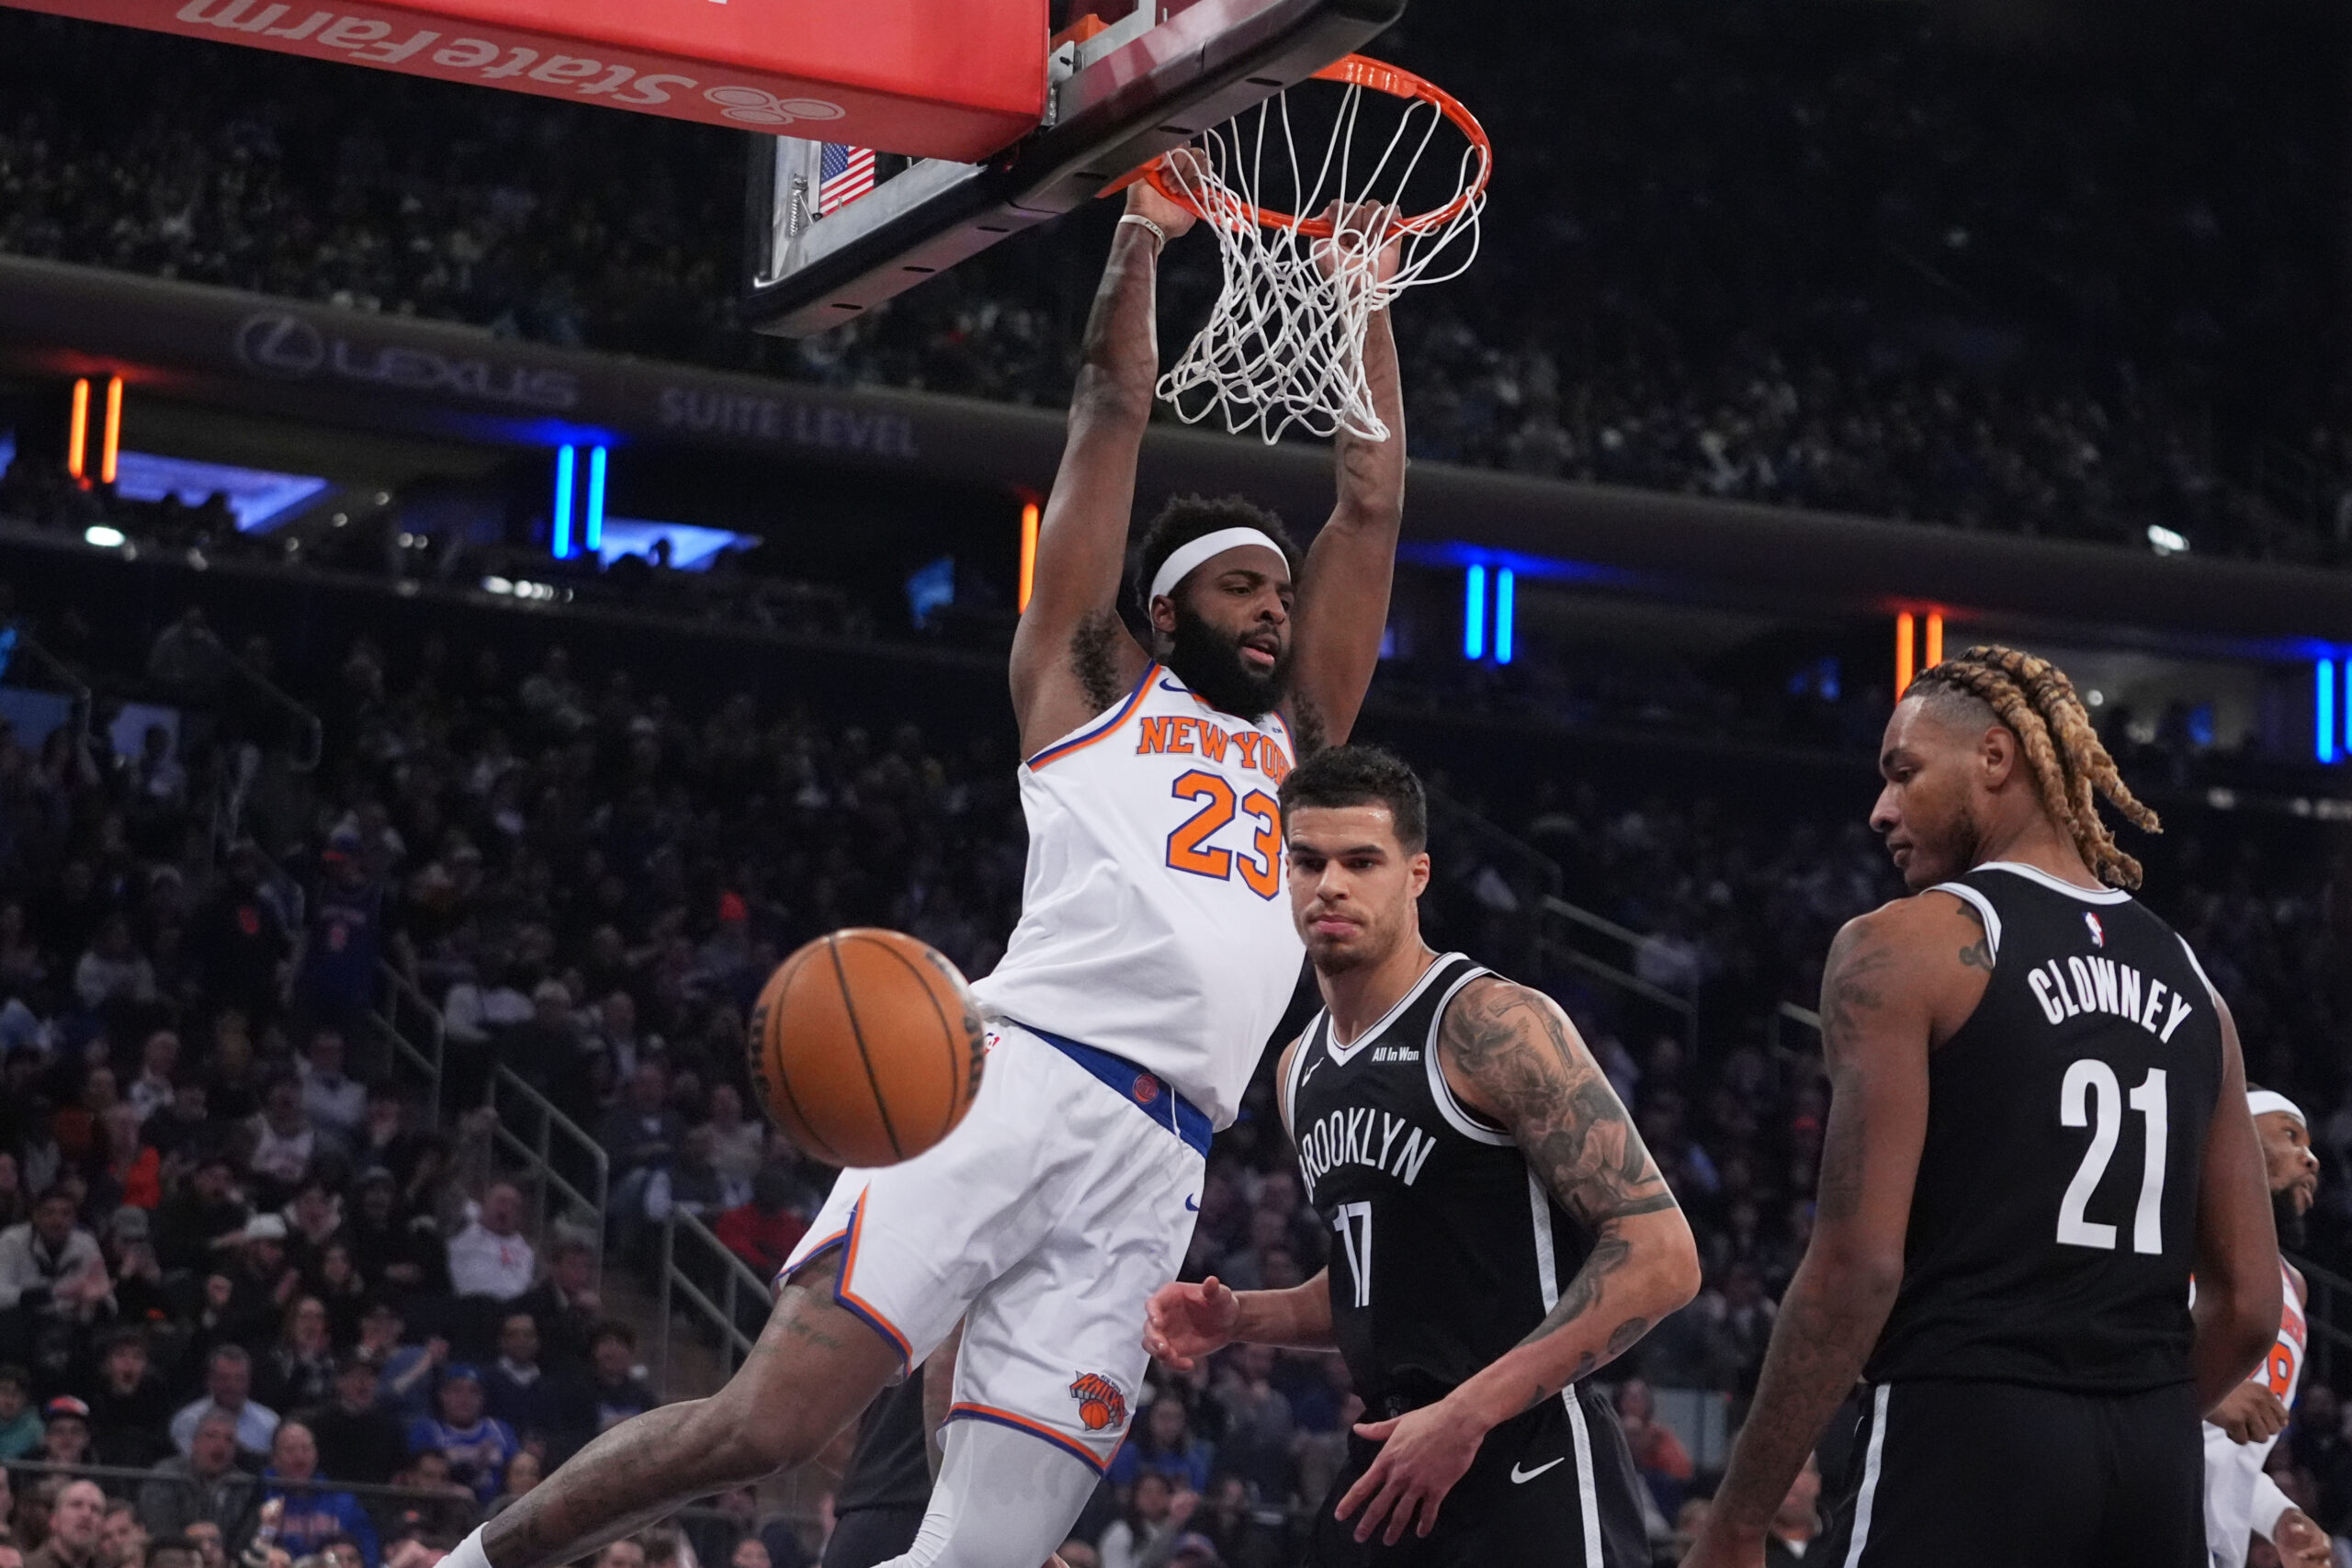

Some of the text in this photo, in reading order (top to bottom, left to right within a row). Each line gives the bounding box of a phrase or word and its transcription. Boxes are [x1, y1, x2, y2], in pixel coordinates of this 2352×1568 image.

[432, 38, 697, 106] State
[334, 342, 577, 409] LEXUS
[659, 386, 918, 457] SUITE LEVEL
[1136, 716, 1291, 787] NEW YOR
[1165, 769, 1283, 901] 23
[2028, 955, 2192, 1043] CLOWNEY
[1372, 1046, 1419, 1062] All In Won
[2056, 1058, 2168, 1255] 21
[1332, 1201, 1372, 1307] 17
